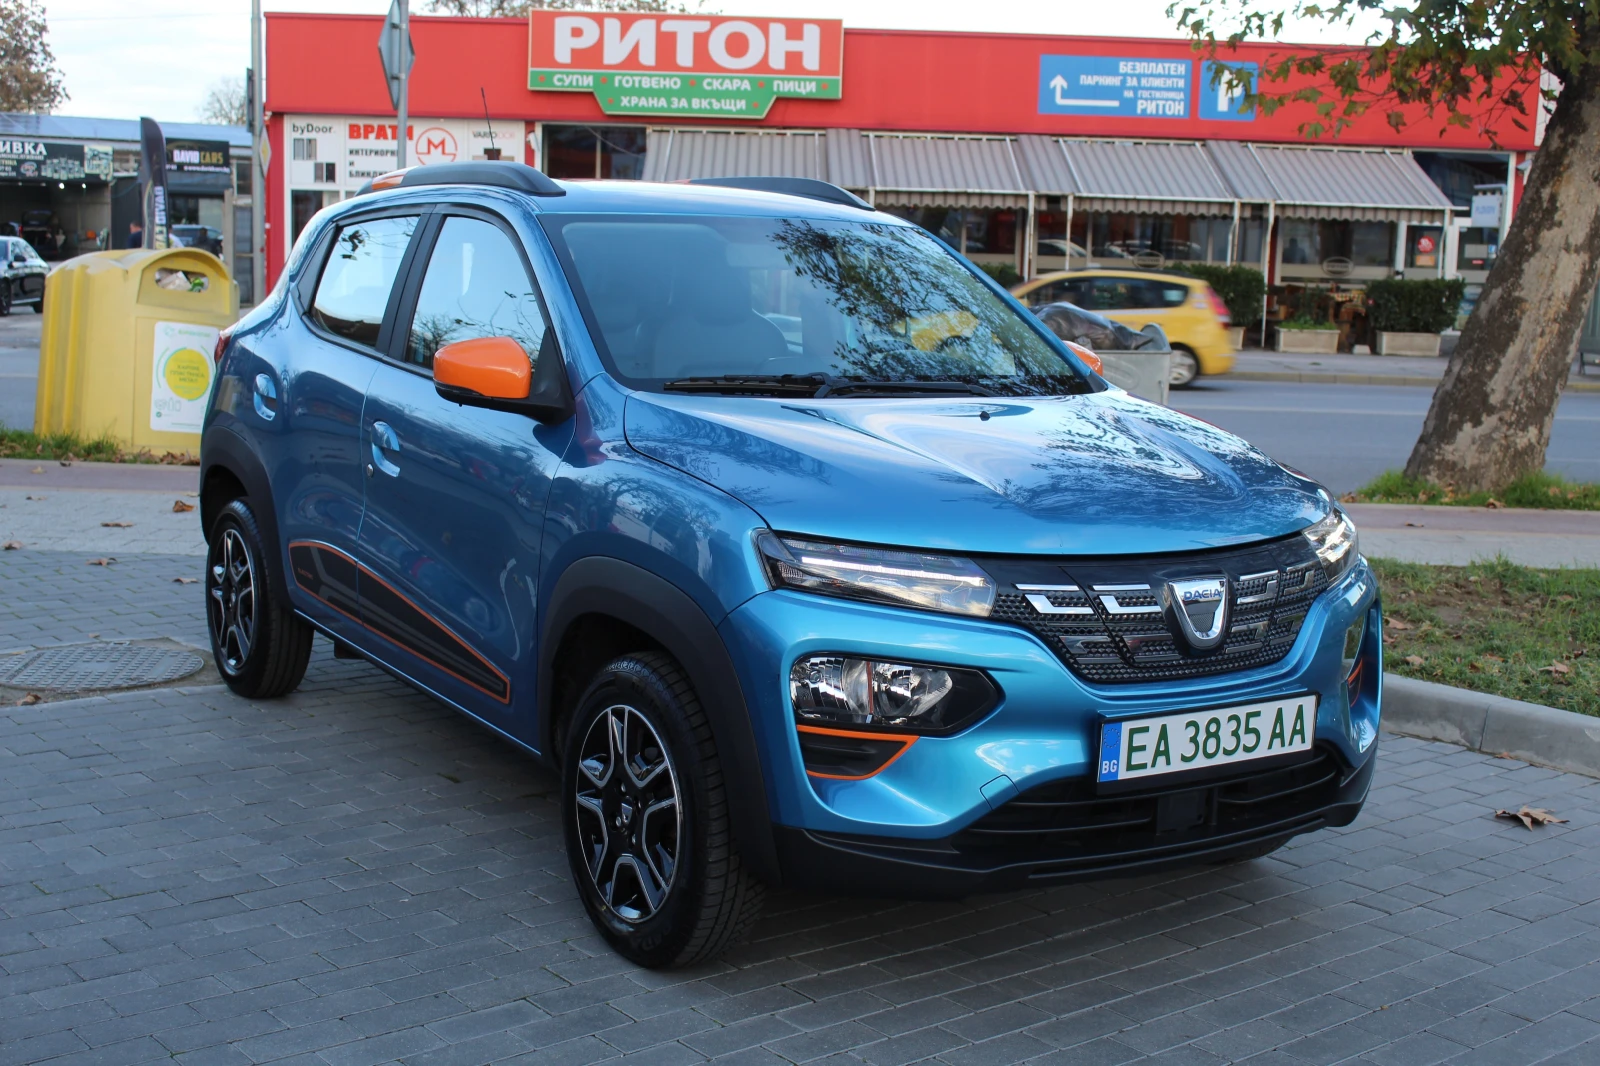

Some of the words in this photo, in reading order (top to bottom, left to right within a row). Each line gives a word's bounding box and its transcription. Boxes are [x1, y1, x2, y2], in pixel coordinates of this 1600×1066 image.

[553, 15, 821, 71] РИТОН
[1119, 60, 1186, 75] БЕЗПЛАТЕН
[553, 73, 593, 87] СУПИ
[614, 75, 682, 89] ГОТВЕНО
[702, 78, 752, 92] СКАРА
[773, 80, 816, 94] ПИЦИ
[1080, 75, 1122, 86] ПАРКИНГ
[1126, 76, 1138, 87] ЗА
[1141, 77, 1184, 88] КЛИЕНТИ
[1123, 89, 1134, 98] НА
[1138, 90, 1184, 100] ГОСТИЛНИЦА
[620, 95, 668, 108] ХРАНА
[670, 97, 689, 109] ЗА
[691, 98, 746, 111] ВКЪЩИ
[1137, 101, 1184, 116] РИТОН
[173, 149, 200, 164] DAVID
[201, 151, 223, 164] CARS
[1183, 588, 1221, 601] DACIA
[1125, 723, 1171, 772] EA
[1180, 710, 1262, 763] 3835
[1267, 704, 1306, 750] AA
[1101, 760, 1118, 774] BG
